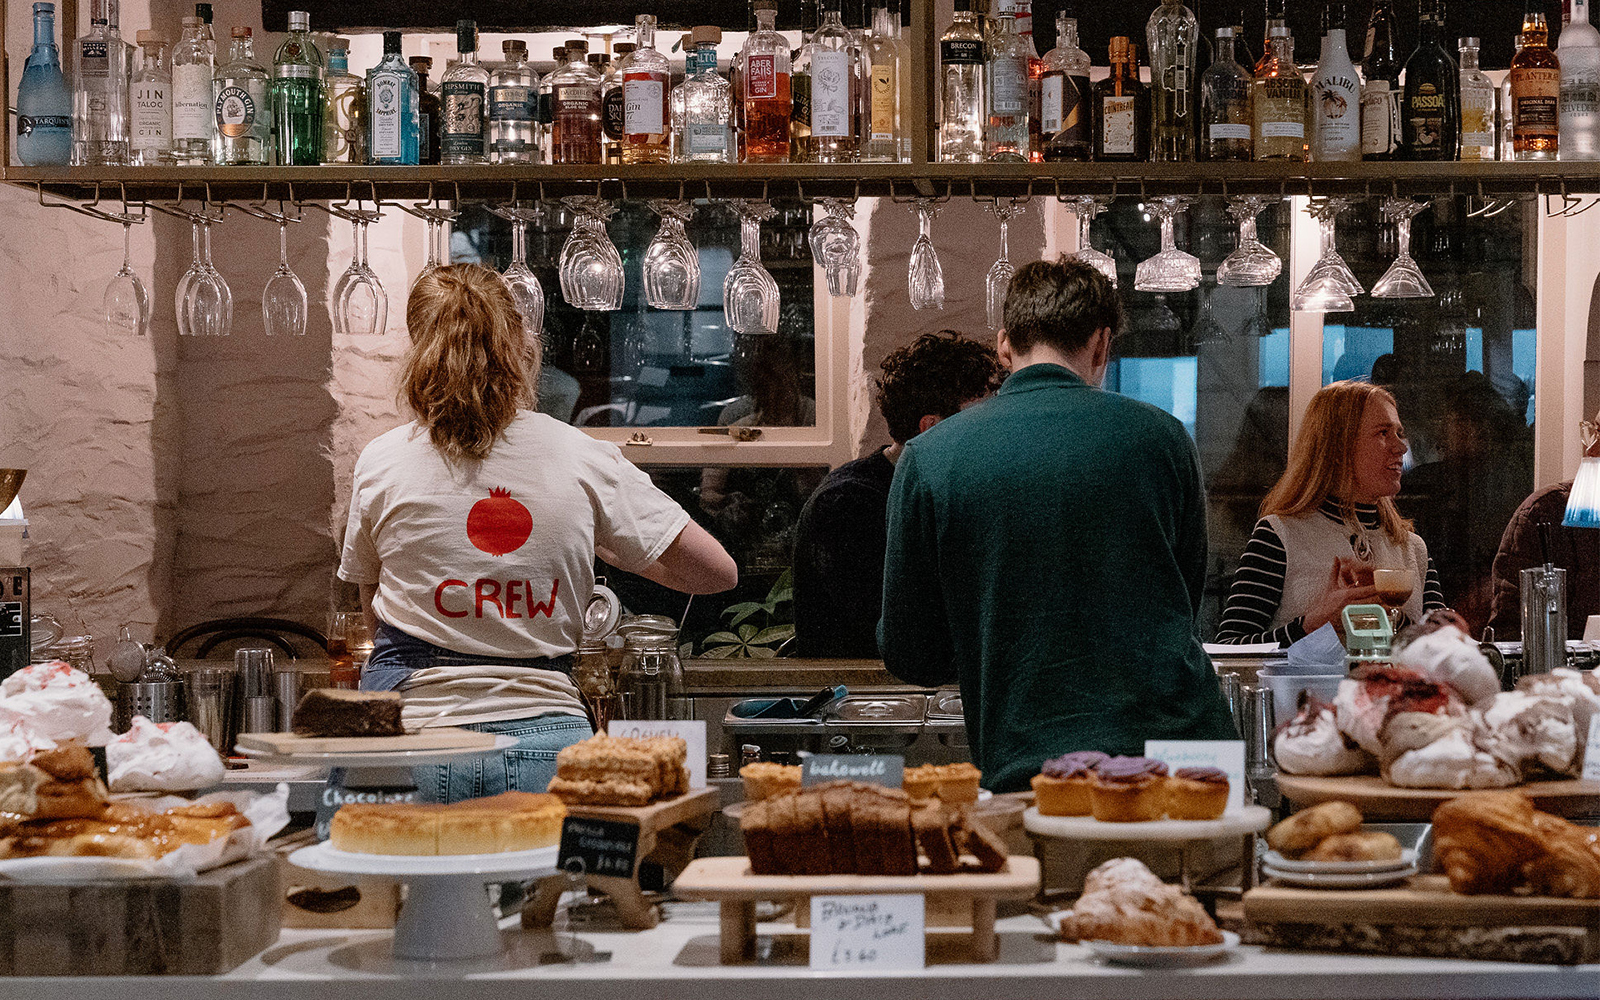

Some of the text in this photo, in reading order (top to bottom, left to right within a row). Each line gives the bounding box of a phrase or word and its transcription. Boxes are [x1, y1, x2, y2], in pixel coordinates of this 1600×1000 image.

[750, 60, 771, 68] ABER
[1315, 76, 1356, 94] MALIBU
[137, 90, 163, 99] JIN
[216, 88, 254, 114] PLYMOUTH GIN
[626, 102, 641, 111] Gin
[434, 578, 560, 619] CREW
